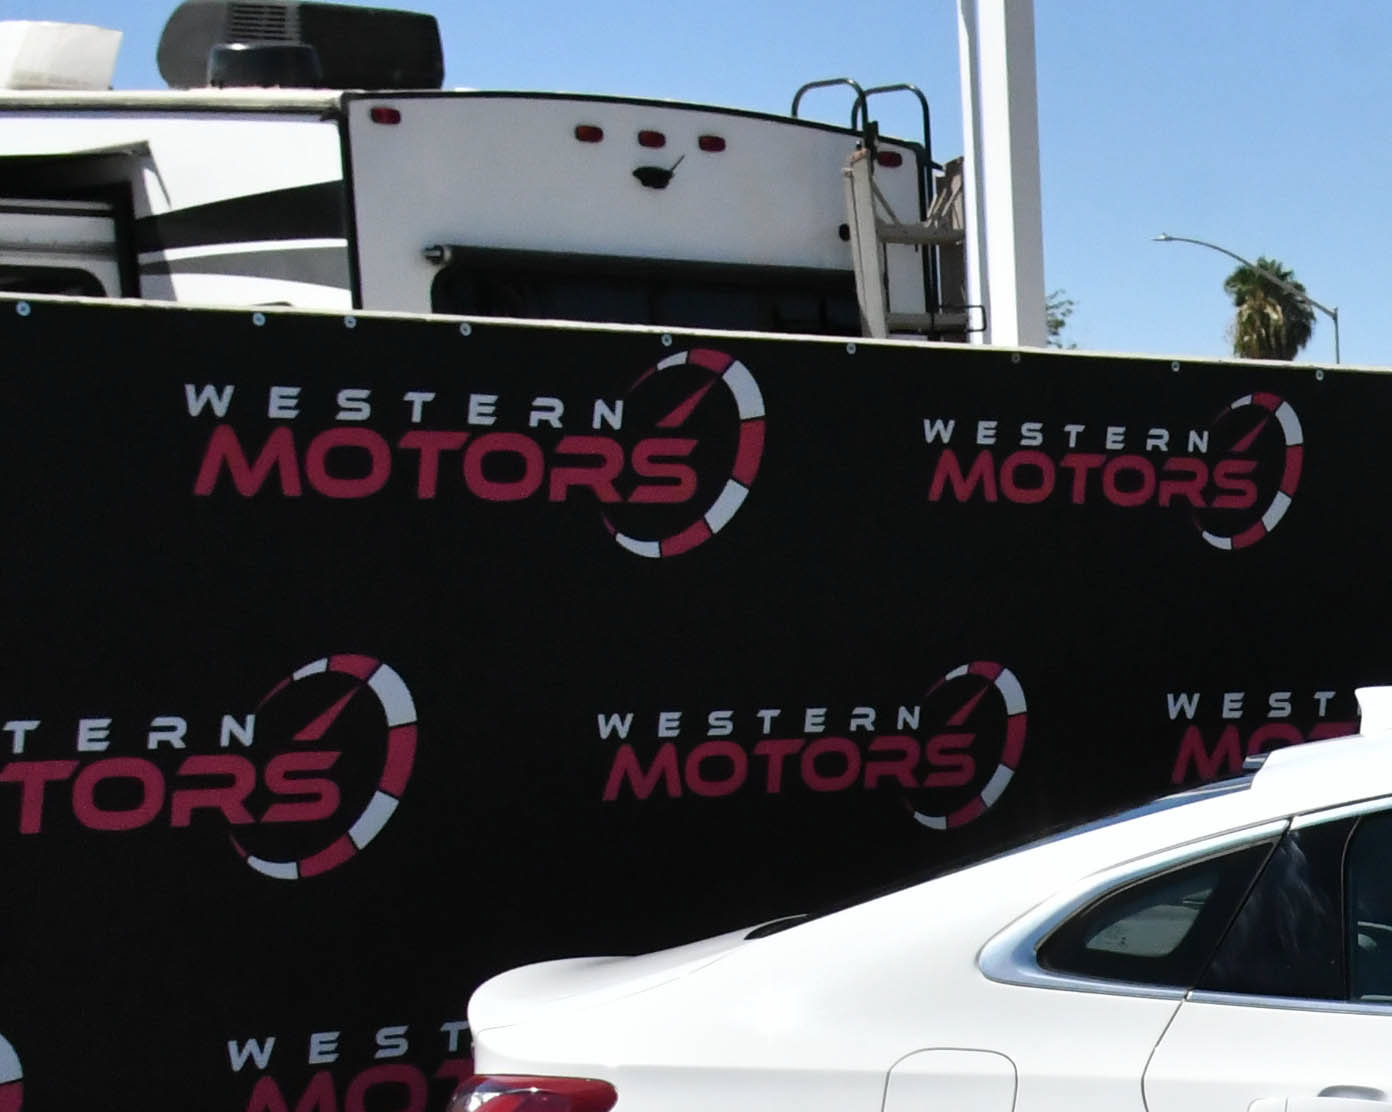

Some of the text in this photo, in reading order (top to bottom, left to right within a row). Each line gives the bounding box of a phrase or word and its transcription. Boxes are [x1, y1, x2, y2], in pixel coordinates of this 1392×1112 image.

[185, 383, 624, 430] WESTERN
[924, 419, 1209, 453] WESTERN
[193, 424, 698, 503] MOTORS
[928, 449, 1258, 509] MOTORS
[597, 705, 921, 740] WESTERN
[1167, 690, 1362, 720] WEST
[2, 714, 256, 754] TERN
[602, 733, 976, 801] MOTORS
[0, 751, 342, 835] TORS
[227, 1020, 474, 1073] WEST
